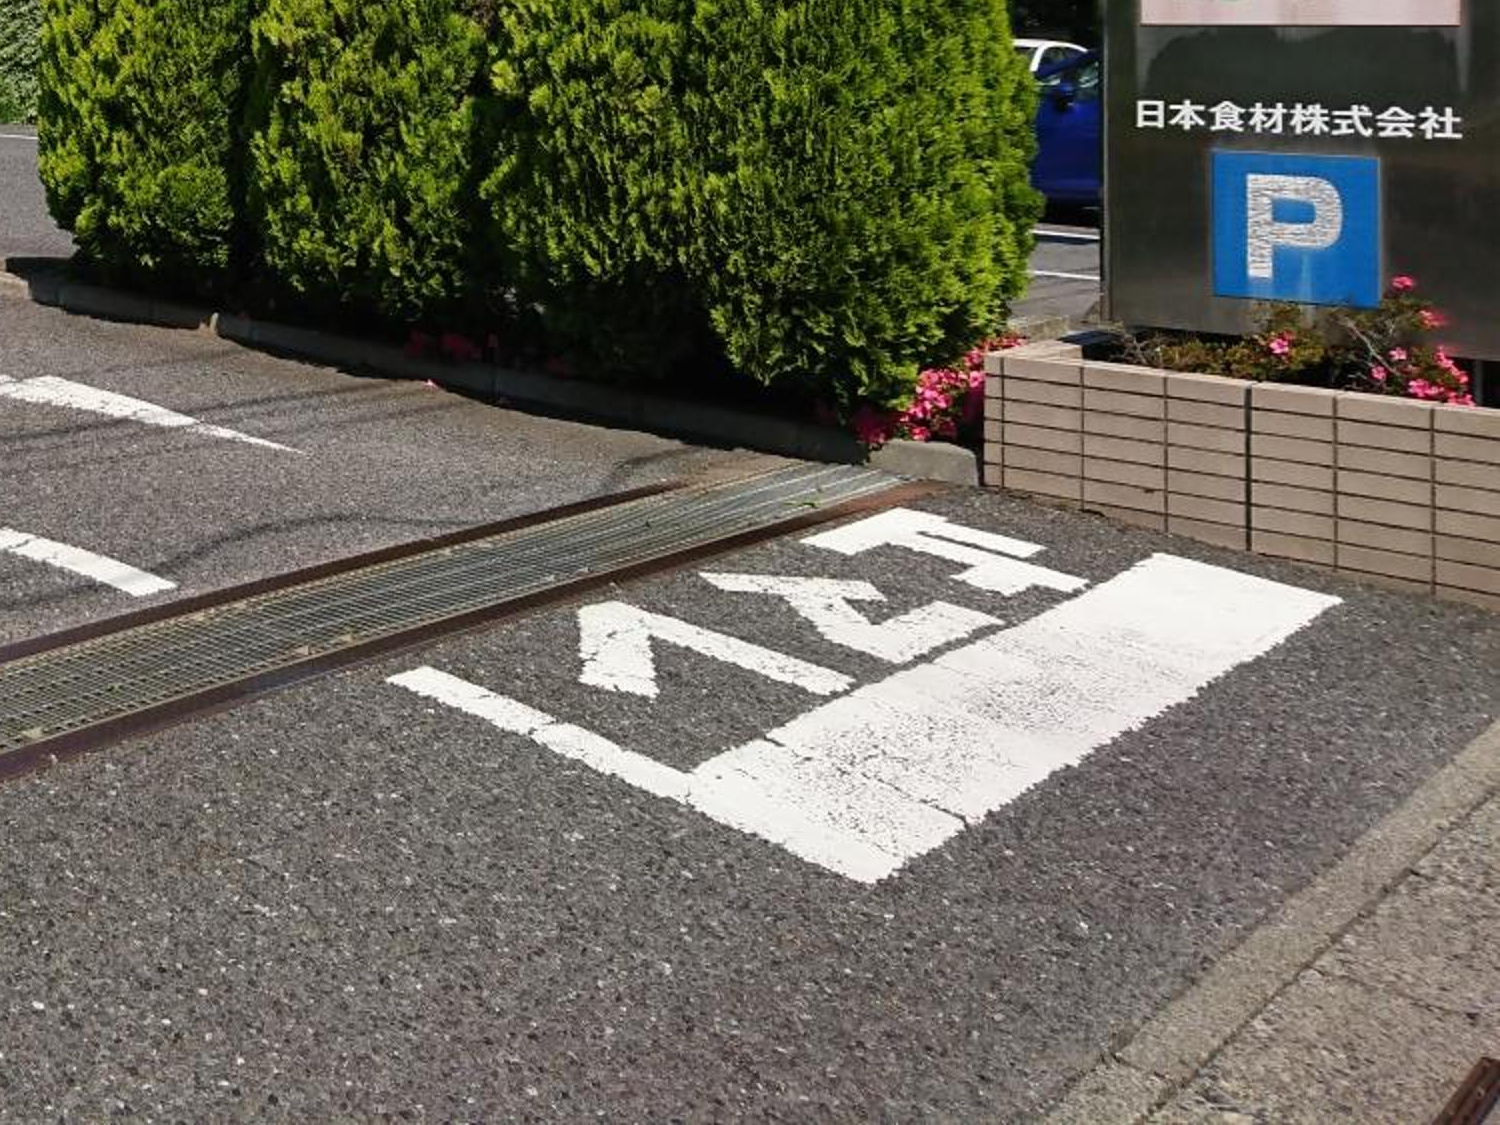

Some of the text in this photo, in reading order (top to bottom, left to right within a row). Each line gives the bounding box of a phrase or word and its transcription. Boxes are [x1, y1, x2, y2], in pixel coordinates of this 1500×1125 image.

[1134, 99, 1464, 140] 日本食材株式会社
[1246, 173, 1343, 279] P
